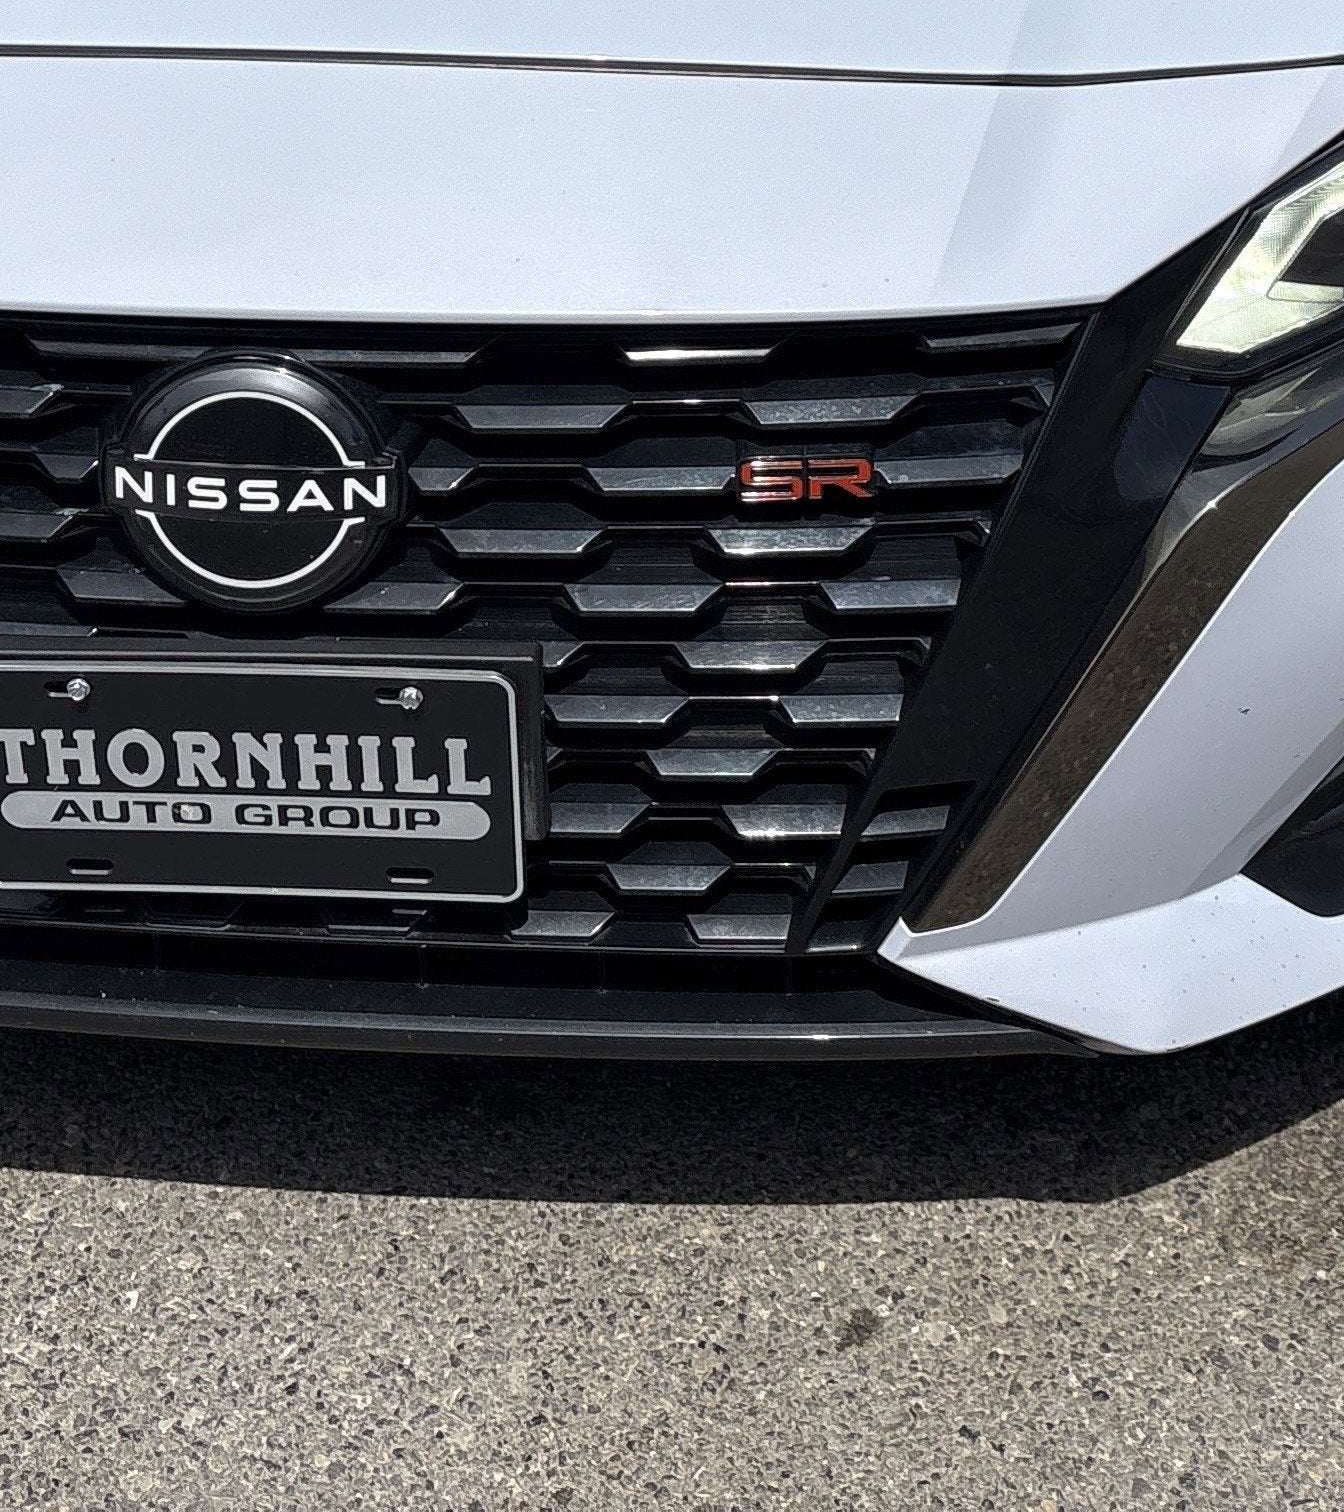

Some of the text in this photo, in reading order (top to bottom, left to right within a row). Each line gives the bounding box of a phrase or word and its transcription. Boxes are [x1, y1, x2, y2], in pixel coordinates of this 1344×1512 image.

[114, 465, 386, 513] NISSAN
[740, 456, 873, 501] SR
[50, 798, 441, 832] AUTO GROUP
